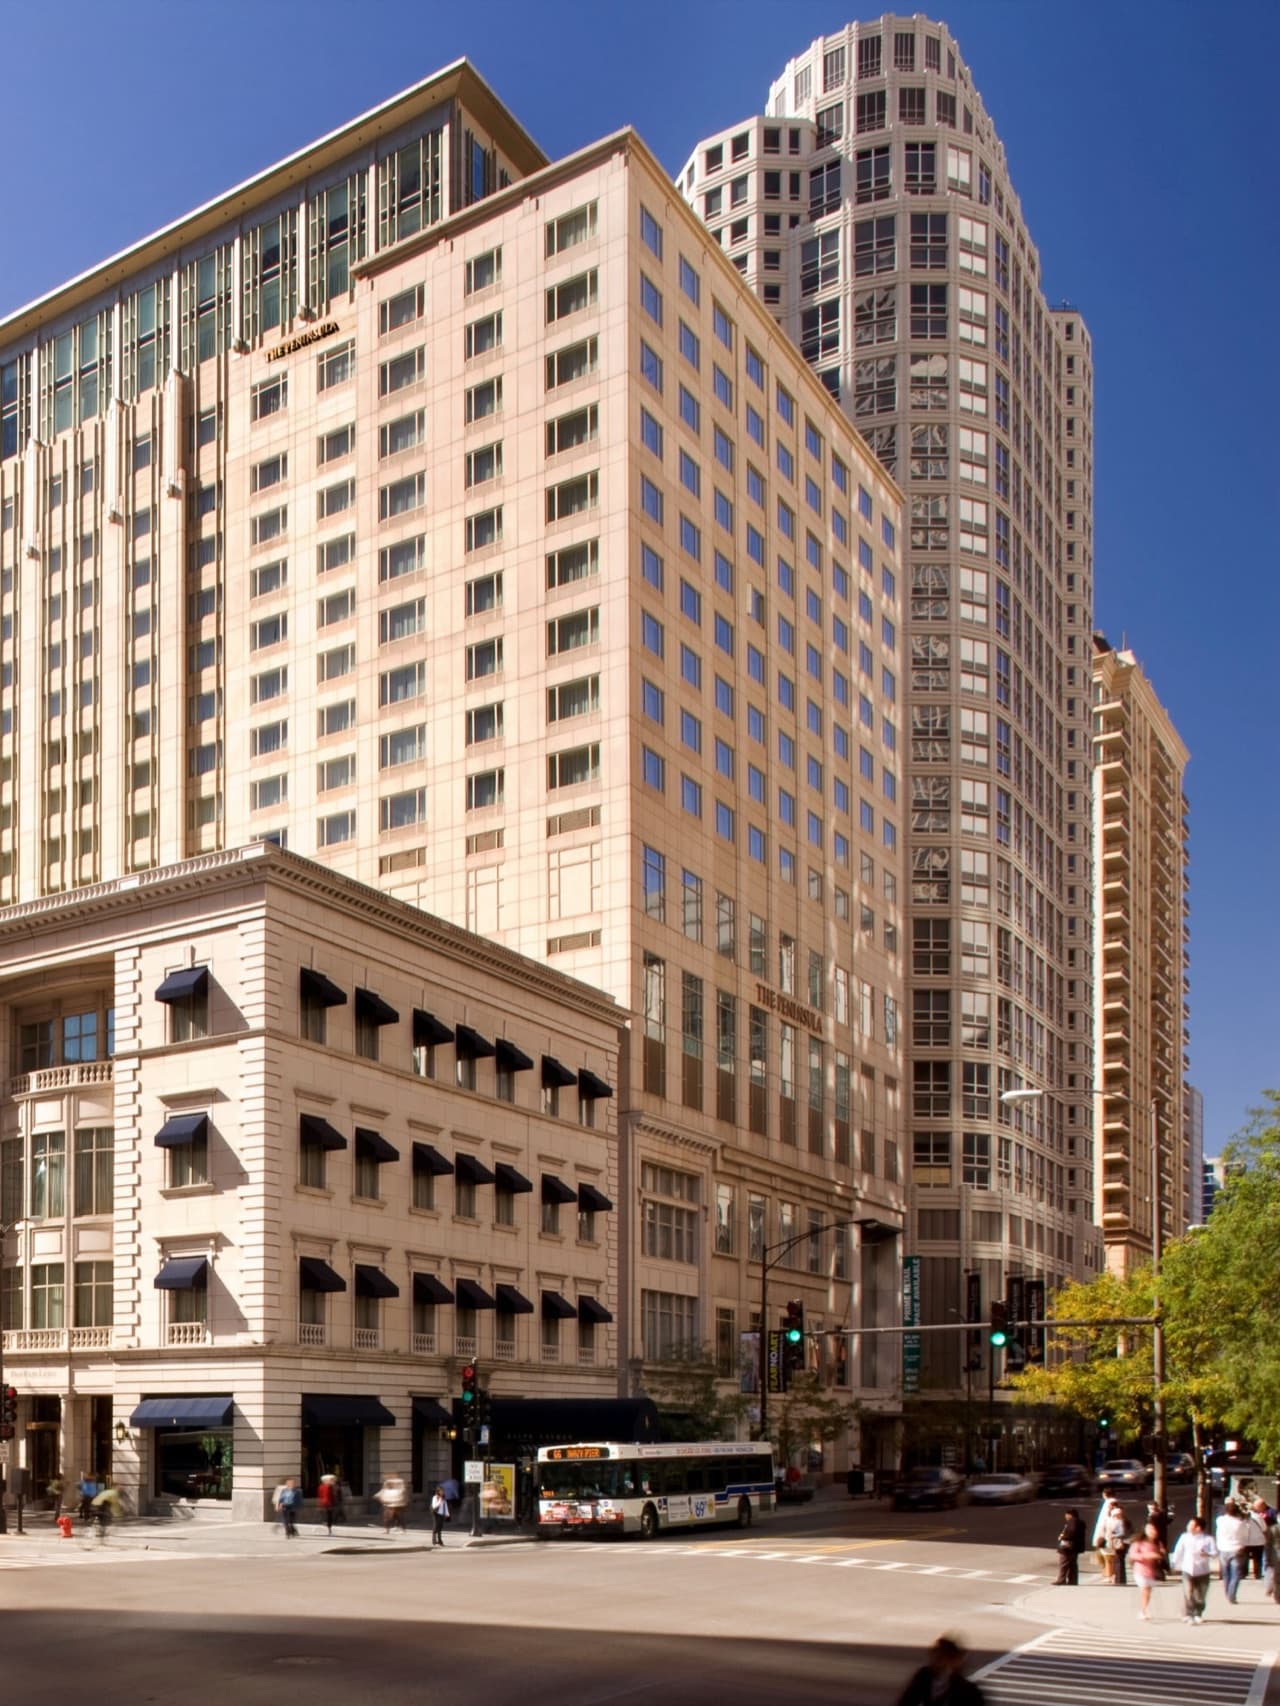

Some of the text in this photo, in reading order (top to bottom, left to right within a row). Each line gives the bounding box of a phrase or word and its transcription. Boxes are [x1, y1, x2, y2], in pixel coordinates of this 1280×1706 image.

[756, 983, 823, 1034] THE PENINSULA
[912, 1258, 921, 1300] AVAILABLE
